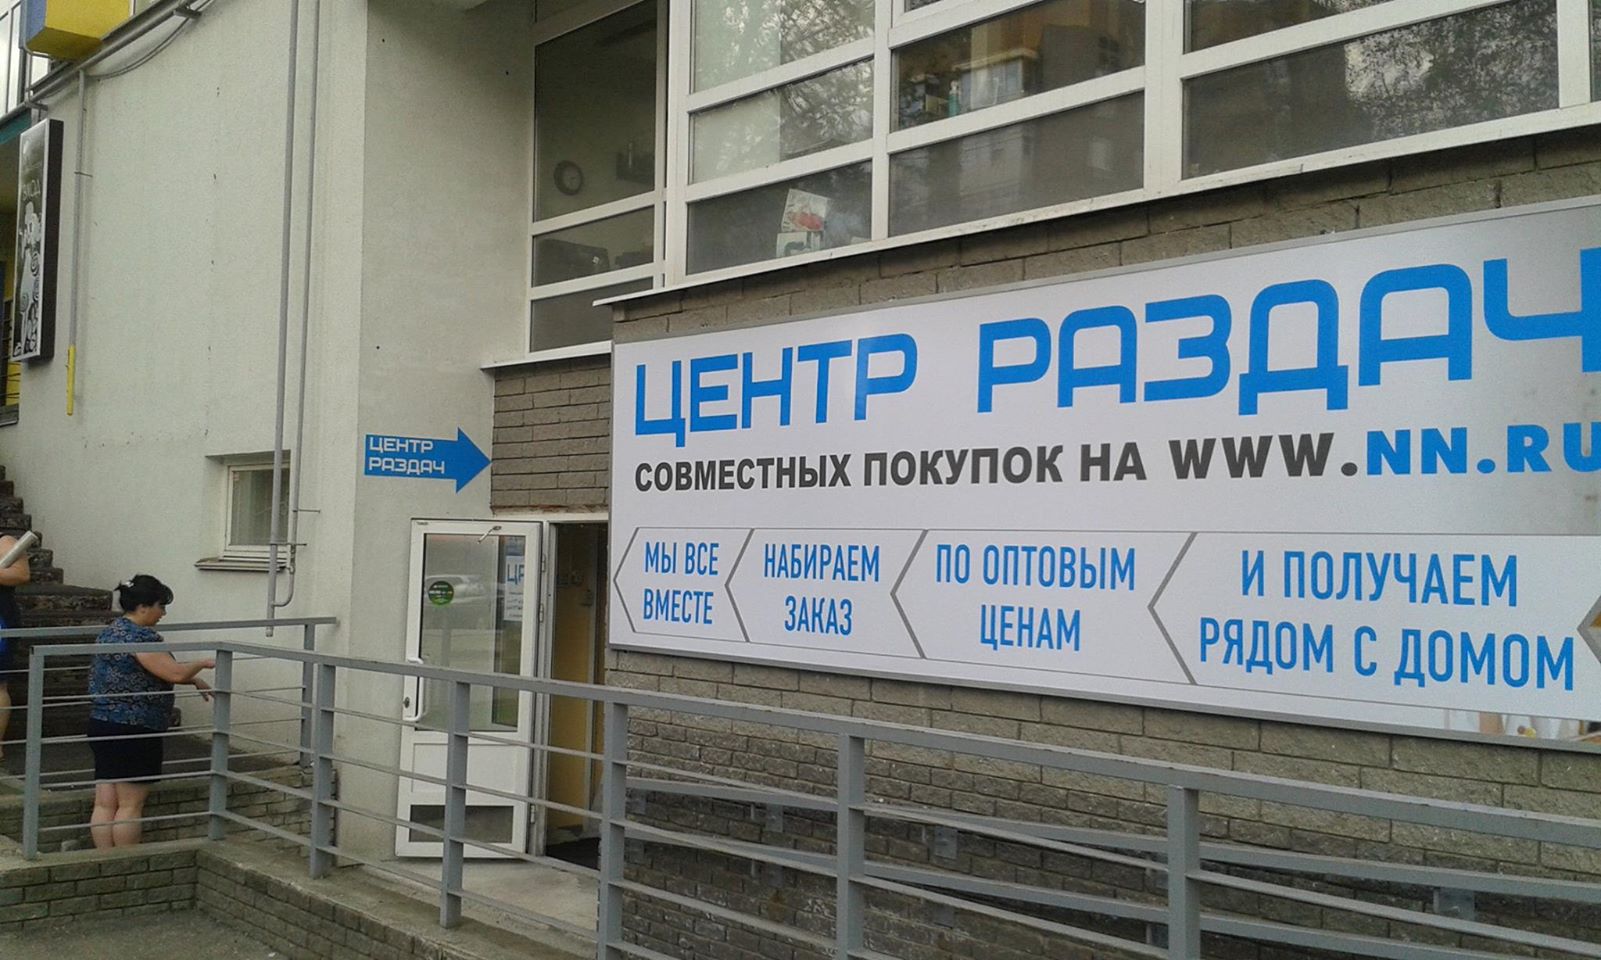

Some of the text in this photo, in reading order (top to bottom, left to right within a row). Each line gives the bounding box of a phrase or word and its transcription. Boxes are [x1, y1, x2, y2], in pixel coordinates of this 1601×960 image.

[634, 247, 1601, 448] ЦЕНТР РАЗДАЧ
[368, 456, 445, 475] РАЗДАЧ
[369, 436, 434, 453] ЦЕНТР
[635, 421, 1601, 491] СОВМЕСТНЫХ ПОКУПОК НА WWW.NN.RU
[644, 543, 720, 576] МЫ ВСЕ
[764, 544, 880, 583] НАБИРАЕМ
[936, 544, 1136, 592] ПО ОПТОВЫМ
[1241, 550, 1519, 608] И ПОЛУЧАЕМ
[643, 588, 714, 625] ВМЕСТЕ
[784, 595, 853, 636] ЗАКАЗ
[980, 604, 1081, 652] ЦЕНАМ
[1200, 617, 1575, 691] РЯДОМ С ДОМОМ
